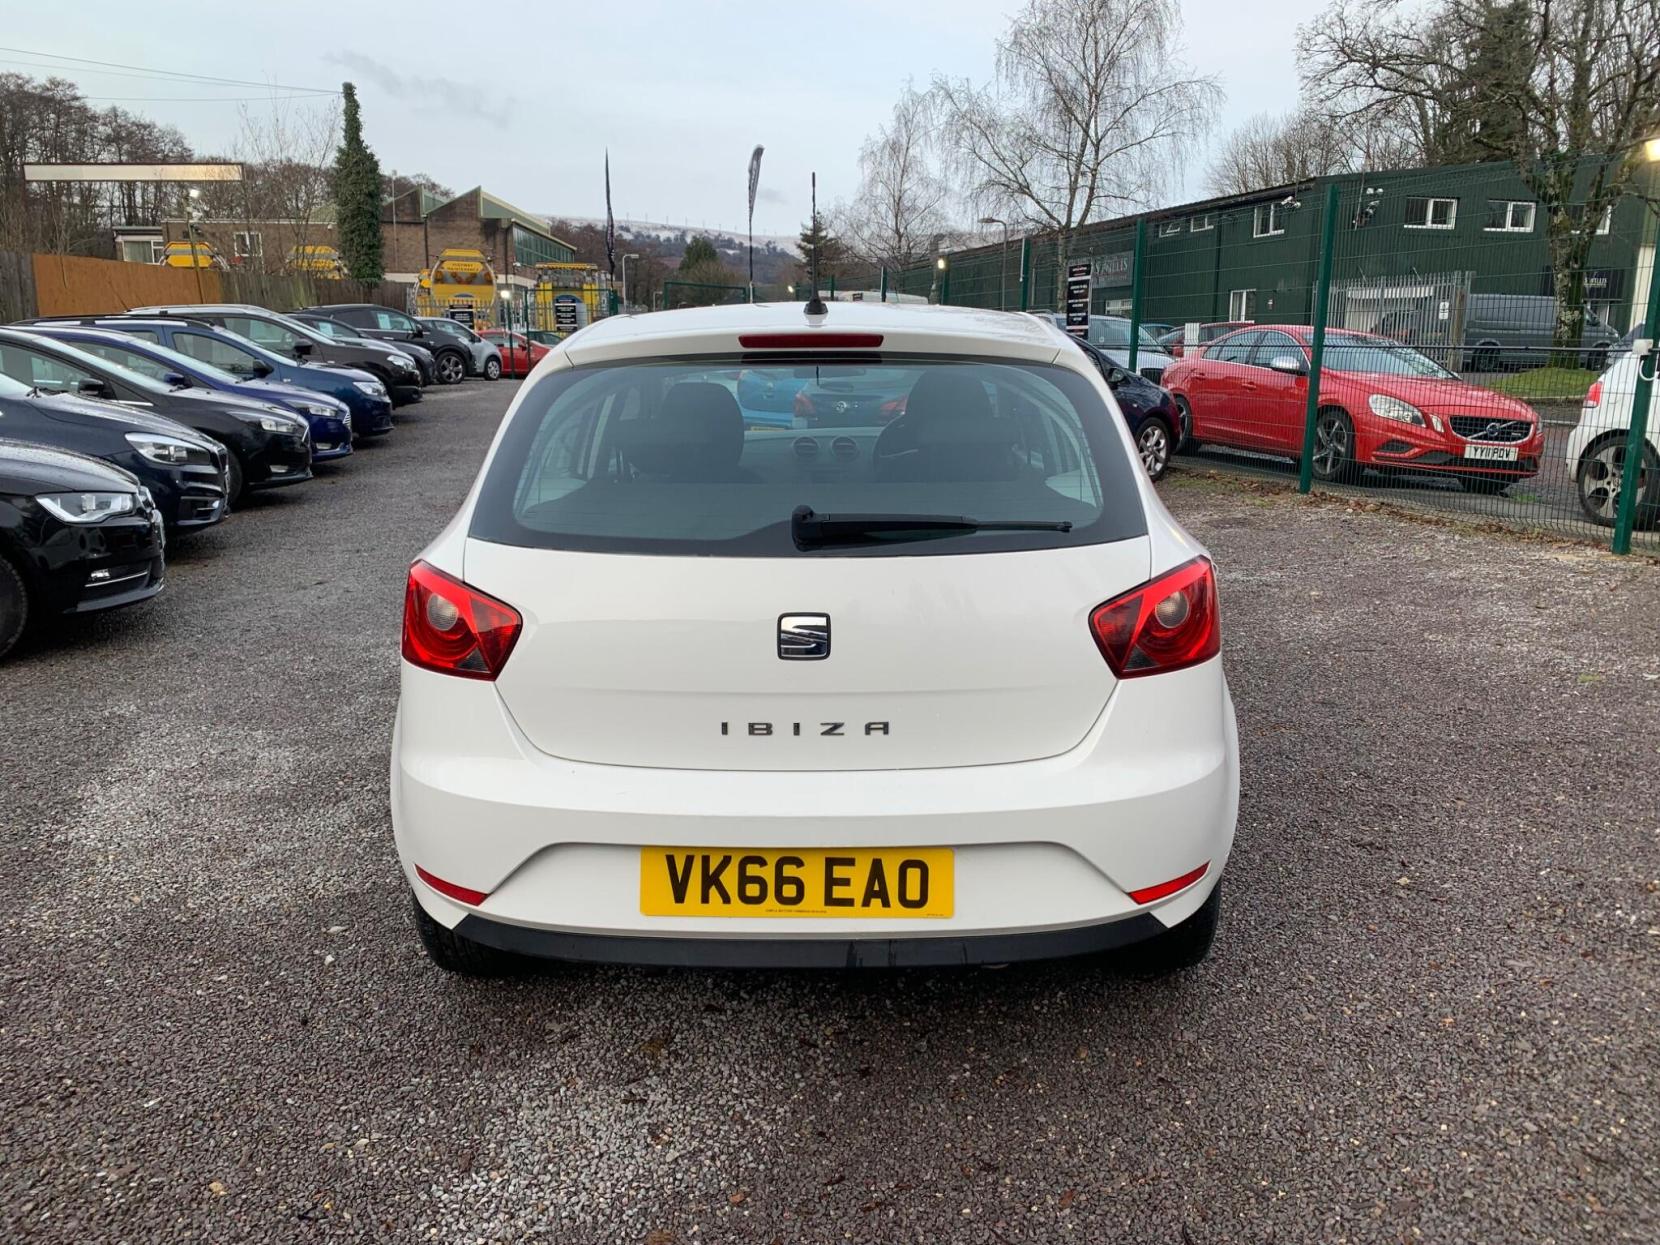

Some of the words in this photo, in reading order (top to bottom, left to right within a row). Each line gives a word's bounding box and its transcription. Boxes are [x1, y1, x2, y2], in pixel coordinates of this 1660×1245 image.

[721, 722, 889, 736] IBIZA
[665, 854, 805, 906] VK66
[824, 857, 929, 909] EAO
